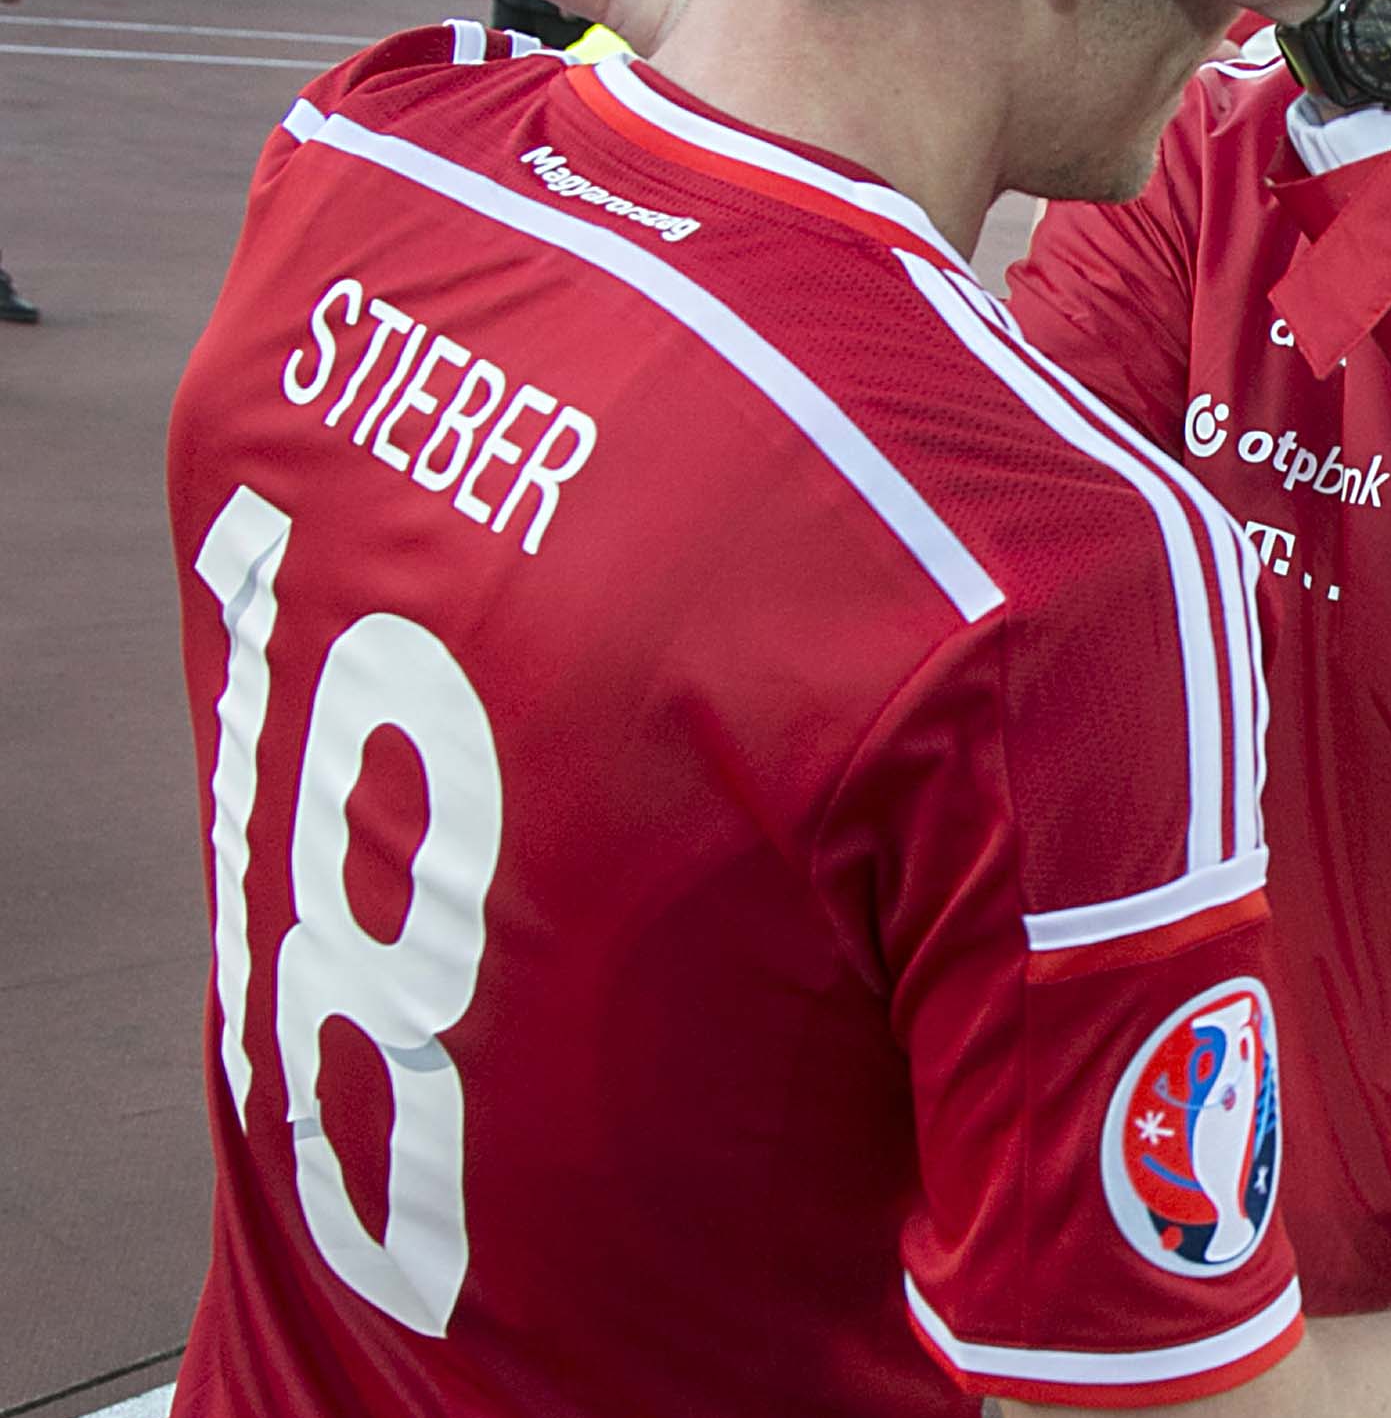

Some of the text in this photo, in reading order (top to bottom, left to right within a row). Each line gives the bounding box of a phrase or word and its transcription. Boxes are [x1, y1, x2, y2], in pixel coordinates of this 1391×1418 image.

[282, 278, 598, 556] STIEBER
[1237, 430, 1391, 508] otpbnk
[194, 484, 504, 1341] 18
